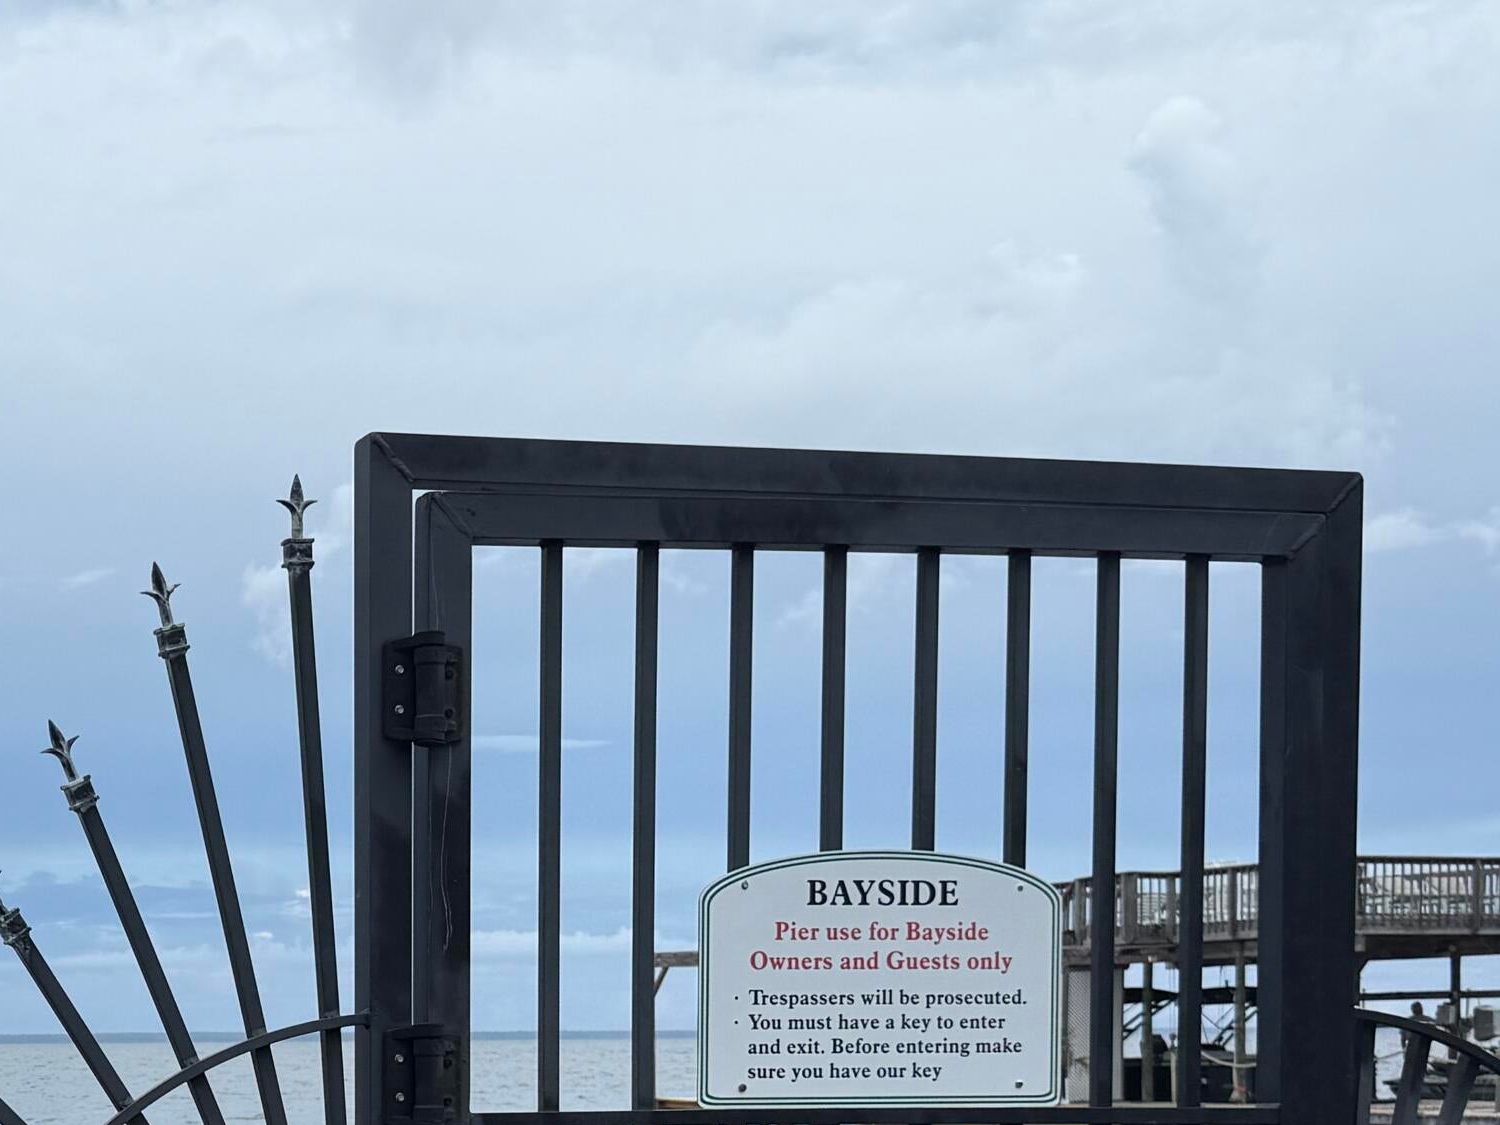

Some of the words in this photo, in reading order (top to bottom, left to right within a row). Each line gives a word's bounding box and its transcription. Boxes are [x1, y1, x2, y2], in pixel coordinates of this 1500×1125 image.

[806, 879, 959, 907] BAYSIDE
[774, 921, 820, 941] Pier
[825, 927, 862, 941] use
[868, 921, 900, 941] for
[905, 921, 989, 946] Bayside
[749, 950, 833, 971] Owners
[839, 950, 880, 971] and
[886, 950, 961, 971] Guests
[966, 950, 1013, 975] only
[748, 989, 855, 1010] Trespassers
[860, 988, 894, 1006] will
[899, 988, 920, 1006] be
[925, 988, 1028, 1009] prosecuted.
[747, 1013, 783, 1031] You
[787, 1015, 833, 1031] must
[837, 1013, 880, 1030] have
[884, 1017, 895, 1030] a
[900, 1013, 932, 1034] key
[936, 1015, 954, 1030] to
[959, 1015, 1007, 1030] enter
[747, 1037, 781, 1055] and
[786, 1037, 825, 1055] exit.
[830, 1037, 891, 1055] Before
[895, 1036, 971, 1058] entering
[975, 1036, 1023, 1054] make
[747, 1067, 786, 1080] sure
[790, 1067, 824, 1083] you
[829, 1062, 872, 1079] have
[876, 1066, 907, 1079] our
[911, 1061, 943, 1082] key
